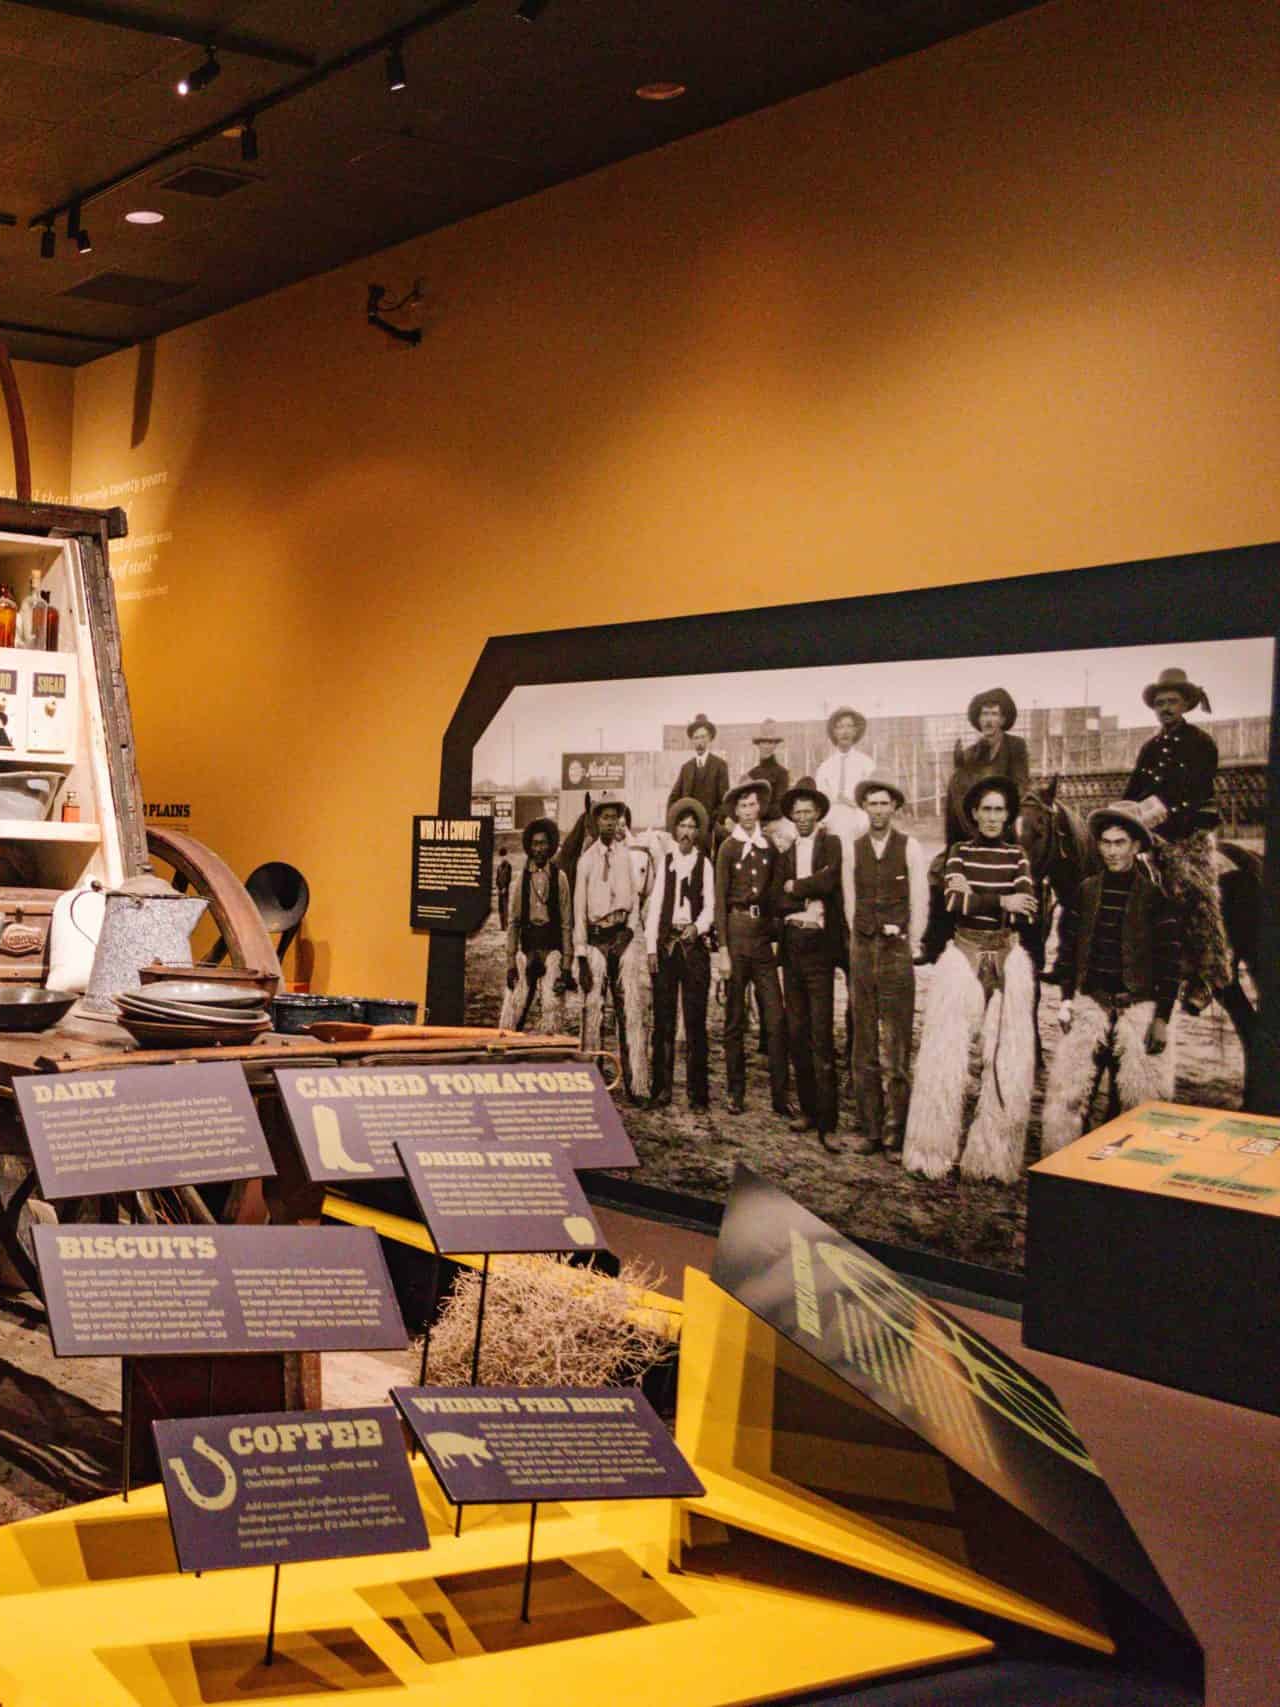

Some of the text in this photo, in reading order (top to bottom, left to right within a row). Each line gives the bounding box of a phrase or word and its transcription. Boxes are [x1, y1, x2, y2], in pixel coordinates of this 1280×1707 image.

[37, 675, 65, 693] SUGAR
[149, 804, 191, 817] PLAINS
[31, 1079, 116, 1104] DAIRY
[295, 1071, 596, 1099] CANNED TOMATOES
[415, 1151, 553, 1167] DRIED FRUIT
[55, 1236, 219, 1259] BISCUITS
[410, 1397, 637, 1414] WHERE'S THE BEEF?
[228, 1419, 384, 1456] COFFEE
